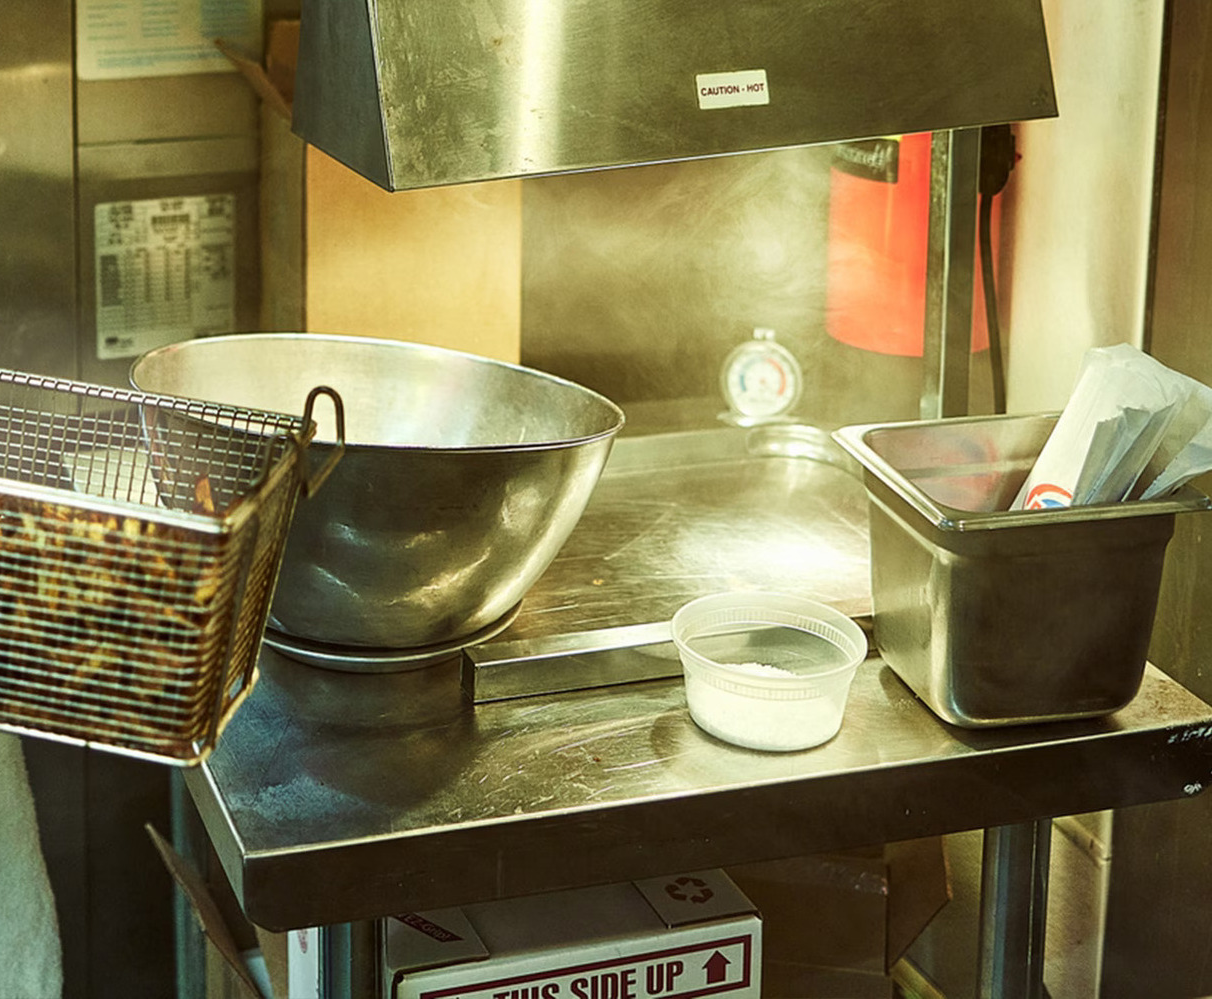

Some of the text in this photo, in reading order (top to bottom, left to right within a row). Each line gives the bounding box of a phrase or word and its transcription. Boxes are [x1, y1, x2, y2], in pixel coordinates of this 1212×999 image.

[700, 85, 740, 96] CAUTION
[746, 83, 764, 93] HOT
[570, 968, 636, 999] SIDE
[646, 960, 684, 995] UP
